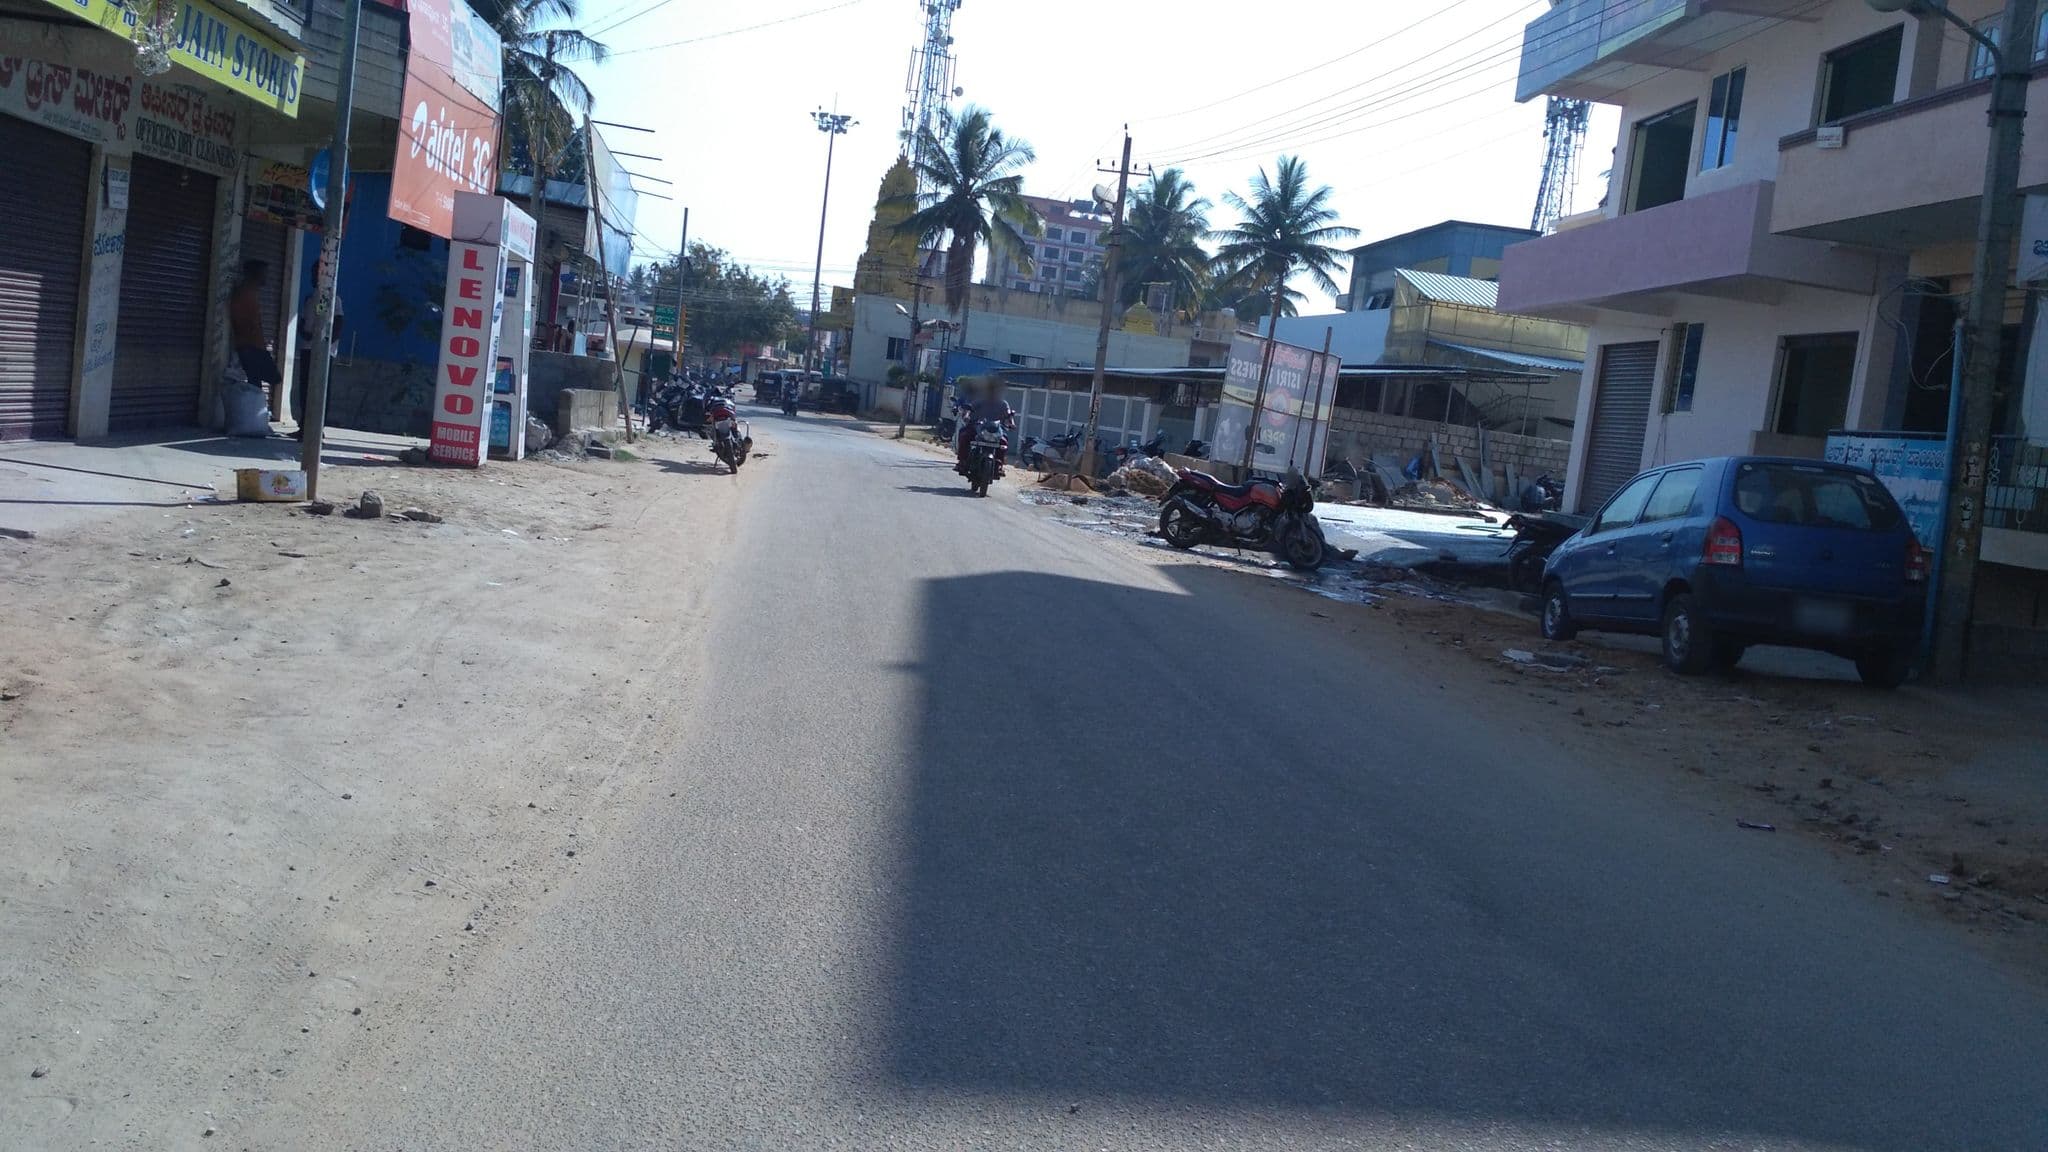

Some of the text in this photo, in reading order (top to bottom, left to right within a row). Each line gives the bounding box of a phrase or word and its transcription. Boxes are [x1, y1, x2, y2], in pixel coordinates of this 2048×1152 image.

[176, 4, 299, 104] JAIN STORES
[425, 107, 490, 195] airtel 3G
[443, 248, 484, 415] LENOVO
[432, 444, 475, 462] SERVICE
[436, 426, 475, 444] MOBILE
